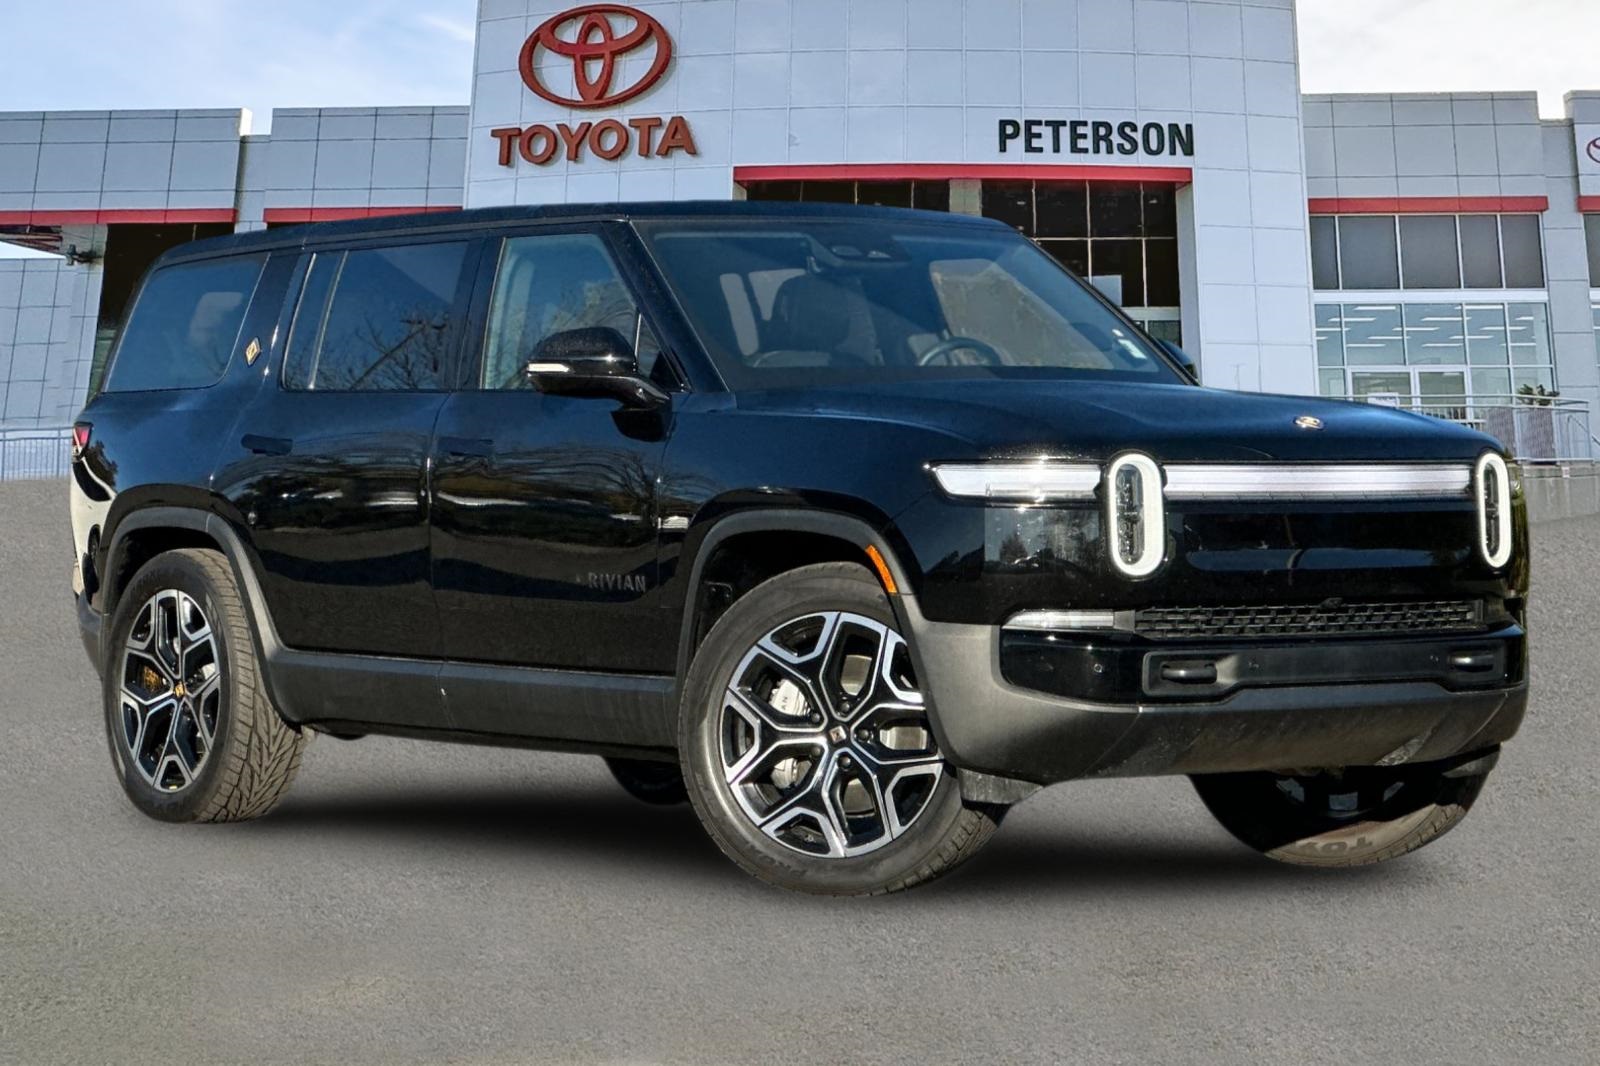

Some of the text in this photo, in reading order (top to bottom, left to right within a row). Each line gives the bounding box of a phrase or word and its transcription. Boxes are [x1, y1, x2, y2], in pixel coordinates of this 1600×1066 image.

[491, 116, 697, 166] TOYOTA
[998, 119, 1194, 156] PETERSON
[588, 571, 646, 593] RIVIAN
